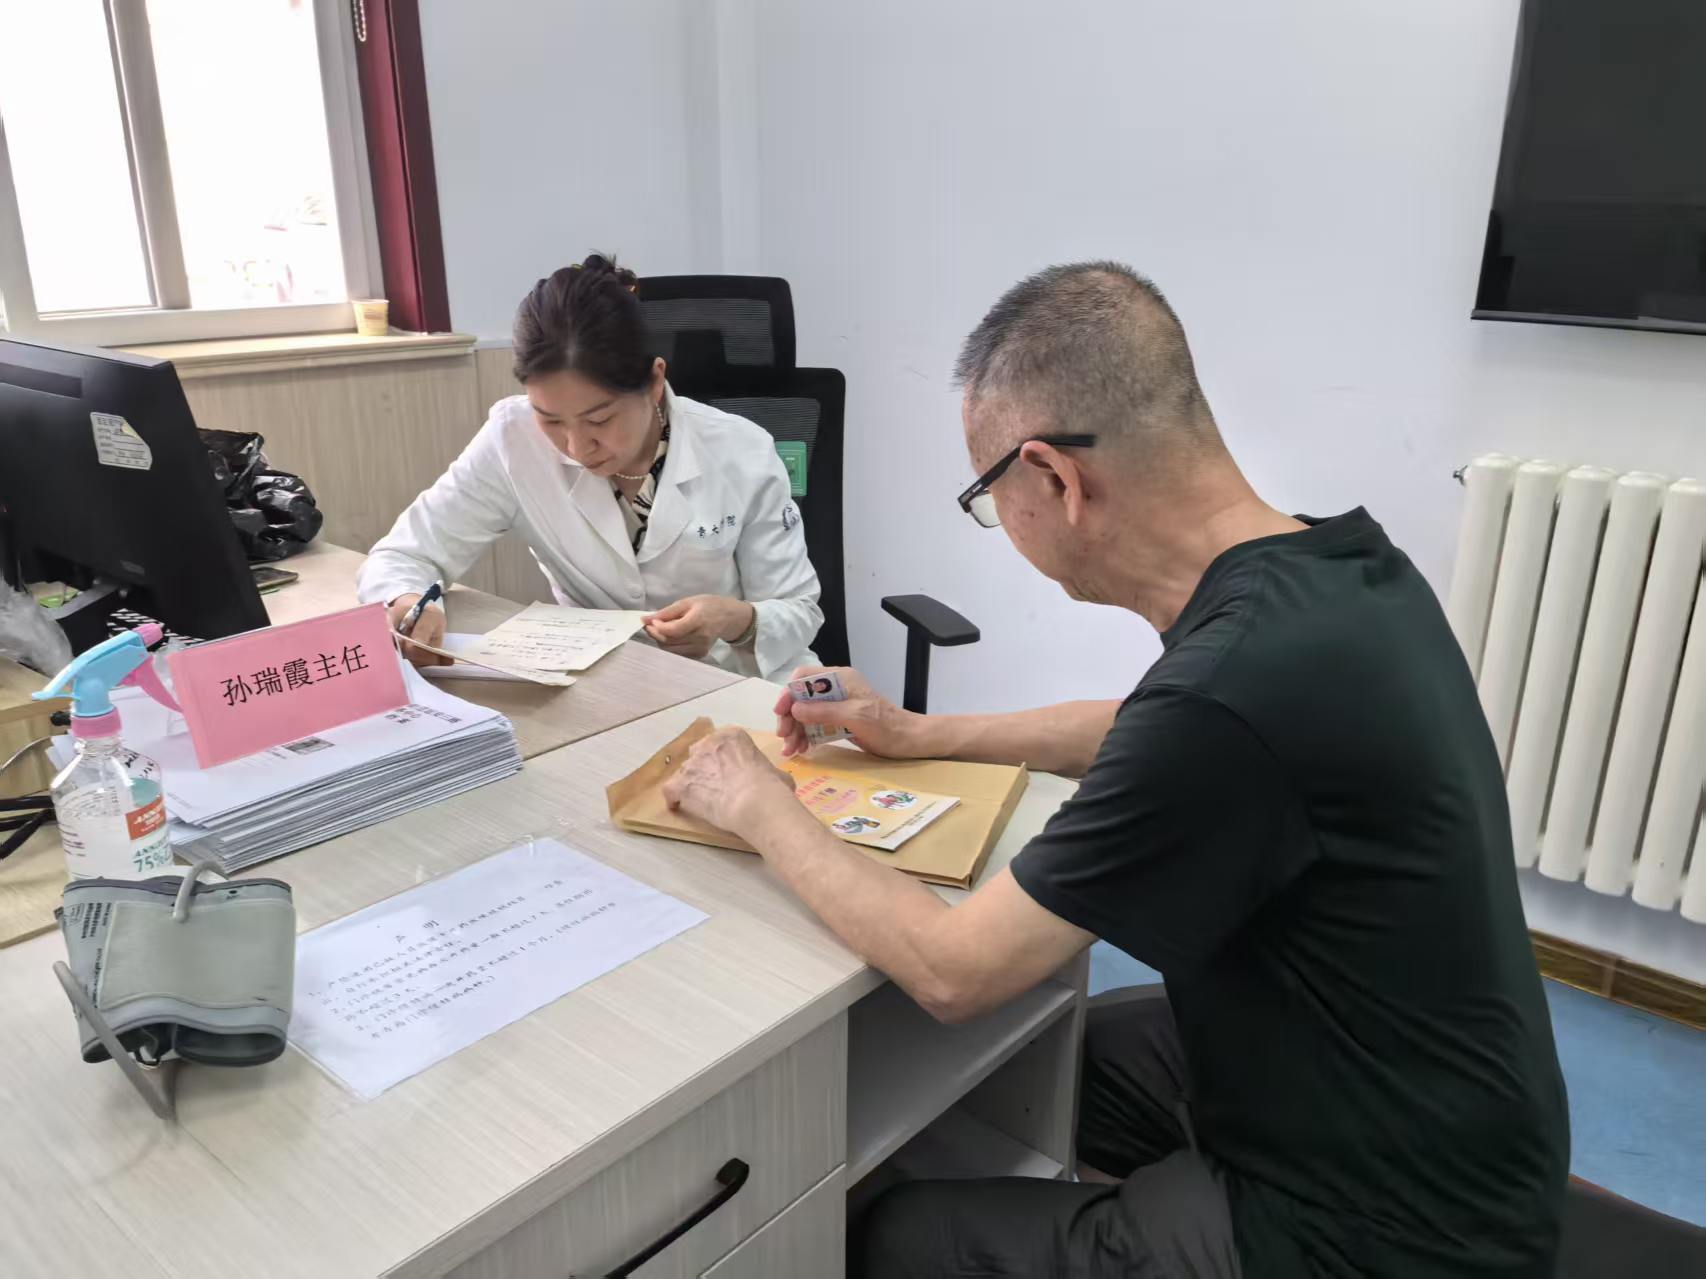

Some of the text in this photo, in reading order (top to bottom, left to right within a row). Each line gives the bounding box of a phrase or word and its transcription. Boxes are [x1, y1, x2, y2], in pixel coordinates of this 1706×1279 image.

[220, 644, 369, 706] 孙瑞霞主任
